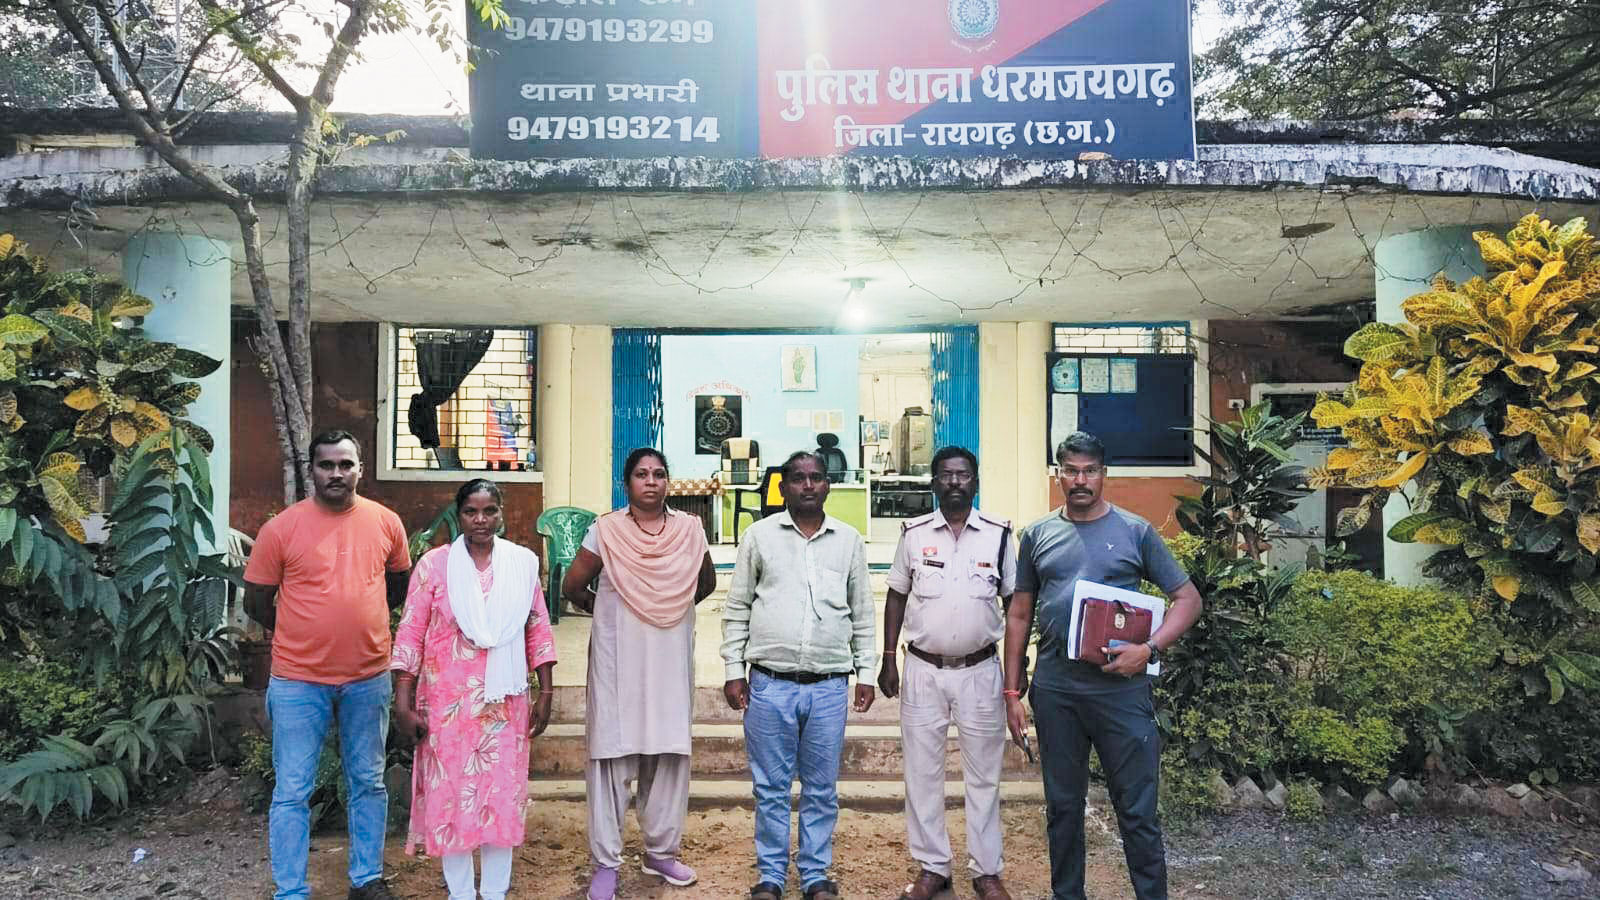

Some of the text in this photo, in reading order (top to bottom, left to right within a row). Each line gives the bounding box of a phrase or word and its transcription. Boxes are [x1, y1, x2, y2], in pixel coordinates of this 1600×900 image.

[504, 17, 714, 43] 9479193299
[520, 78, 700, 103] थाना प्रभारी
[775, 53, 1176, 121] पुलिस थाना धरमजयगढ़
[507, 116, 720, 142] 9479193214
[1023, 118, 1116, 146] (छ.ग.)
